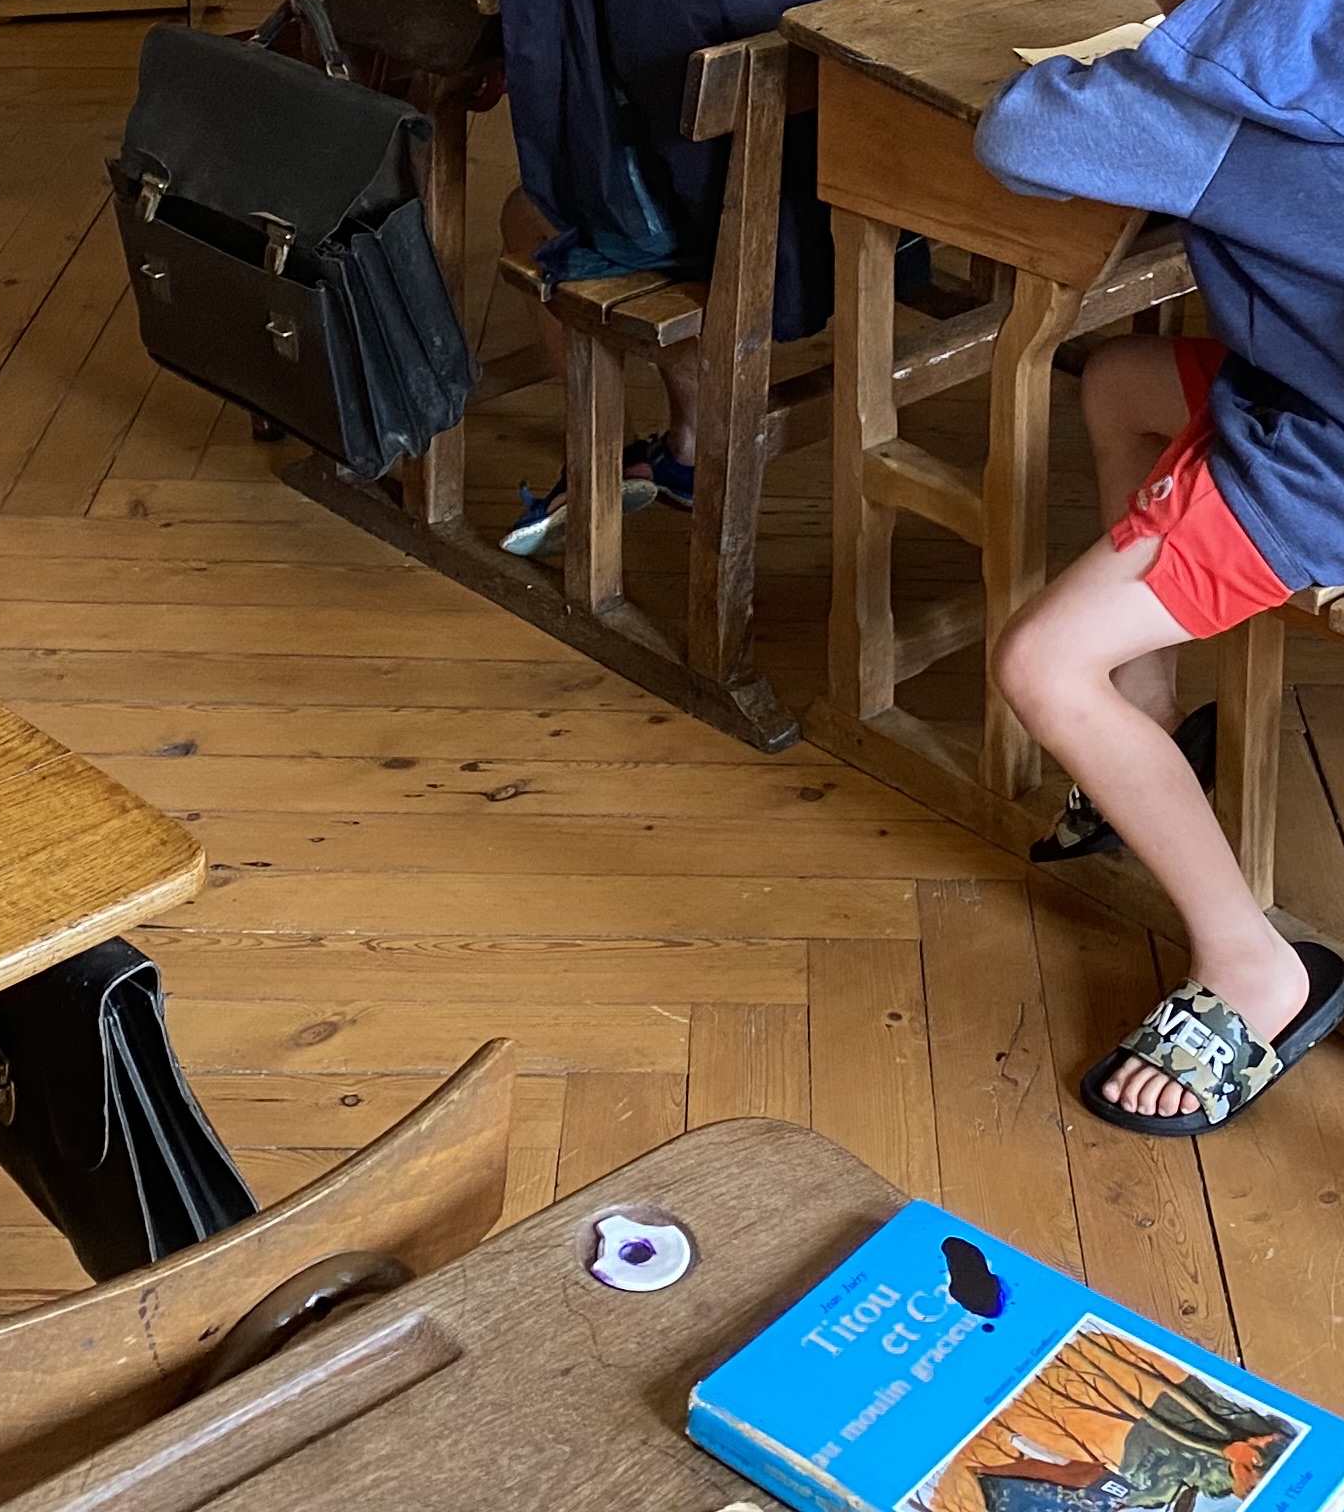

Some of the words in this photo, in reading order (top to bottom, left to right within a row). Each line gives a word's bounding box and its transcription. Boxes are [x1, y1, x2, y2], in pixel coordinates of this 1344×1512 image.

[800, 1284, 902, 1356] Titou
[882, 1321, 920, 1355] et
[840, 1379, 912, 1441] moulin
